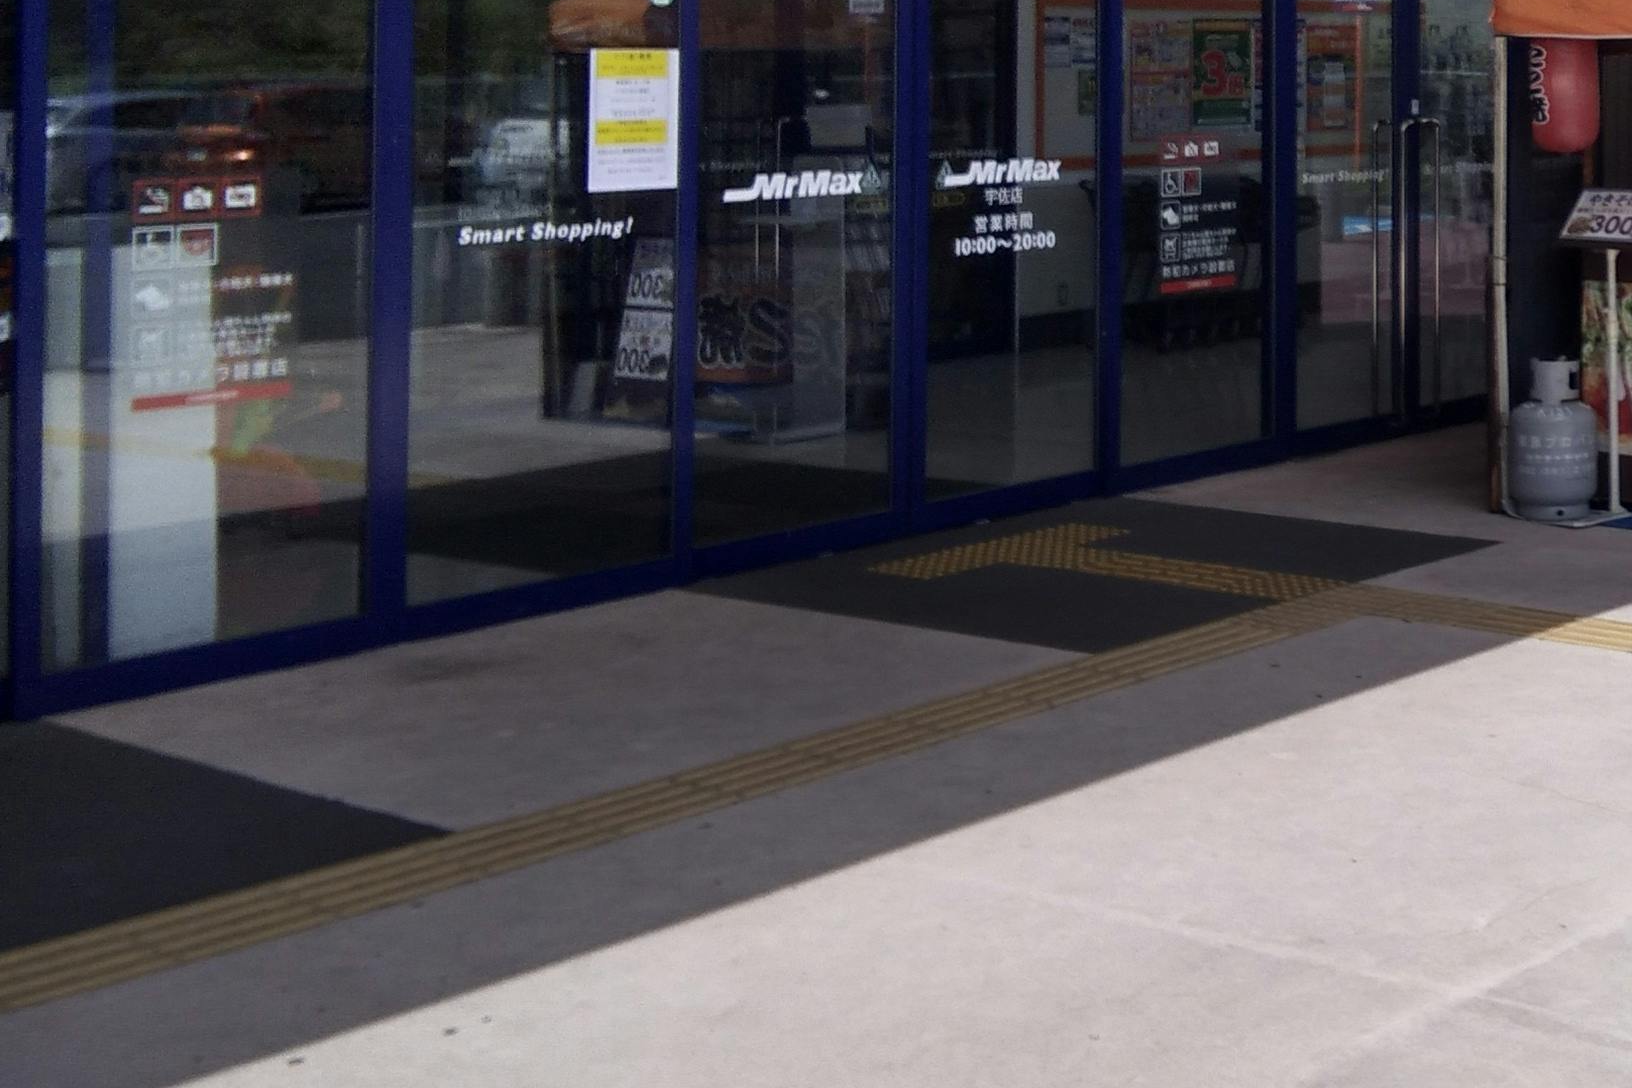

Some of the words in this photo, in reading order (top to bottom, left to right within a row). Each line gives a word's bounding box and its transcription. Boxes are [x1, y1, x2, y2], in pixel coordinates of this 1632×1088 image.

[723, 169, 863, 203] MrMax
[944, 158, 1062, 187] MrMax
[984, 186, 1023, 205] 宇佐店
[458, 225, 526, 246] Smart
[531, 216, 634, 243] Shopping!
[974, 211, 1034, 233] 営業時間
